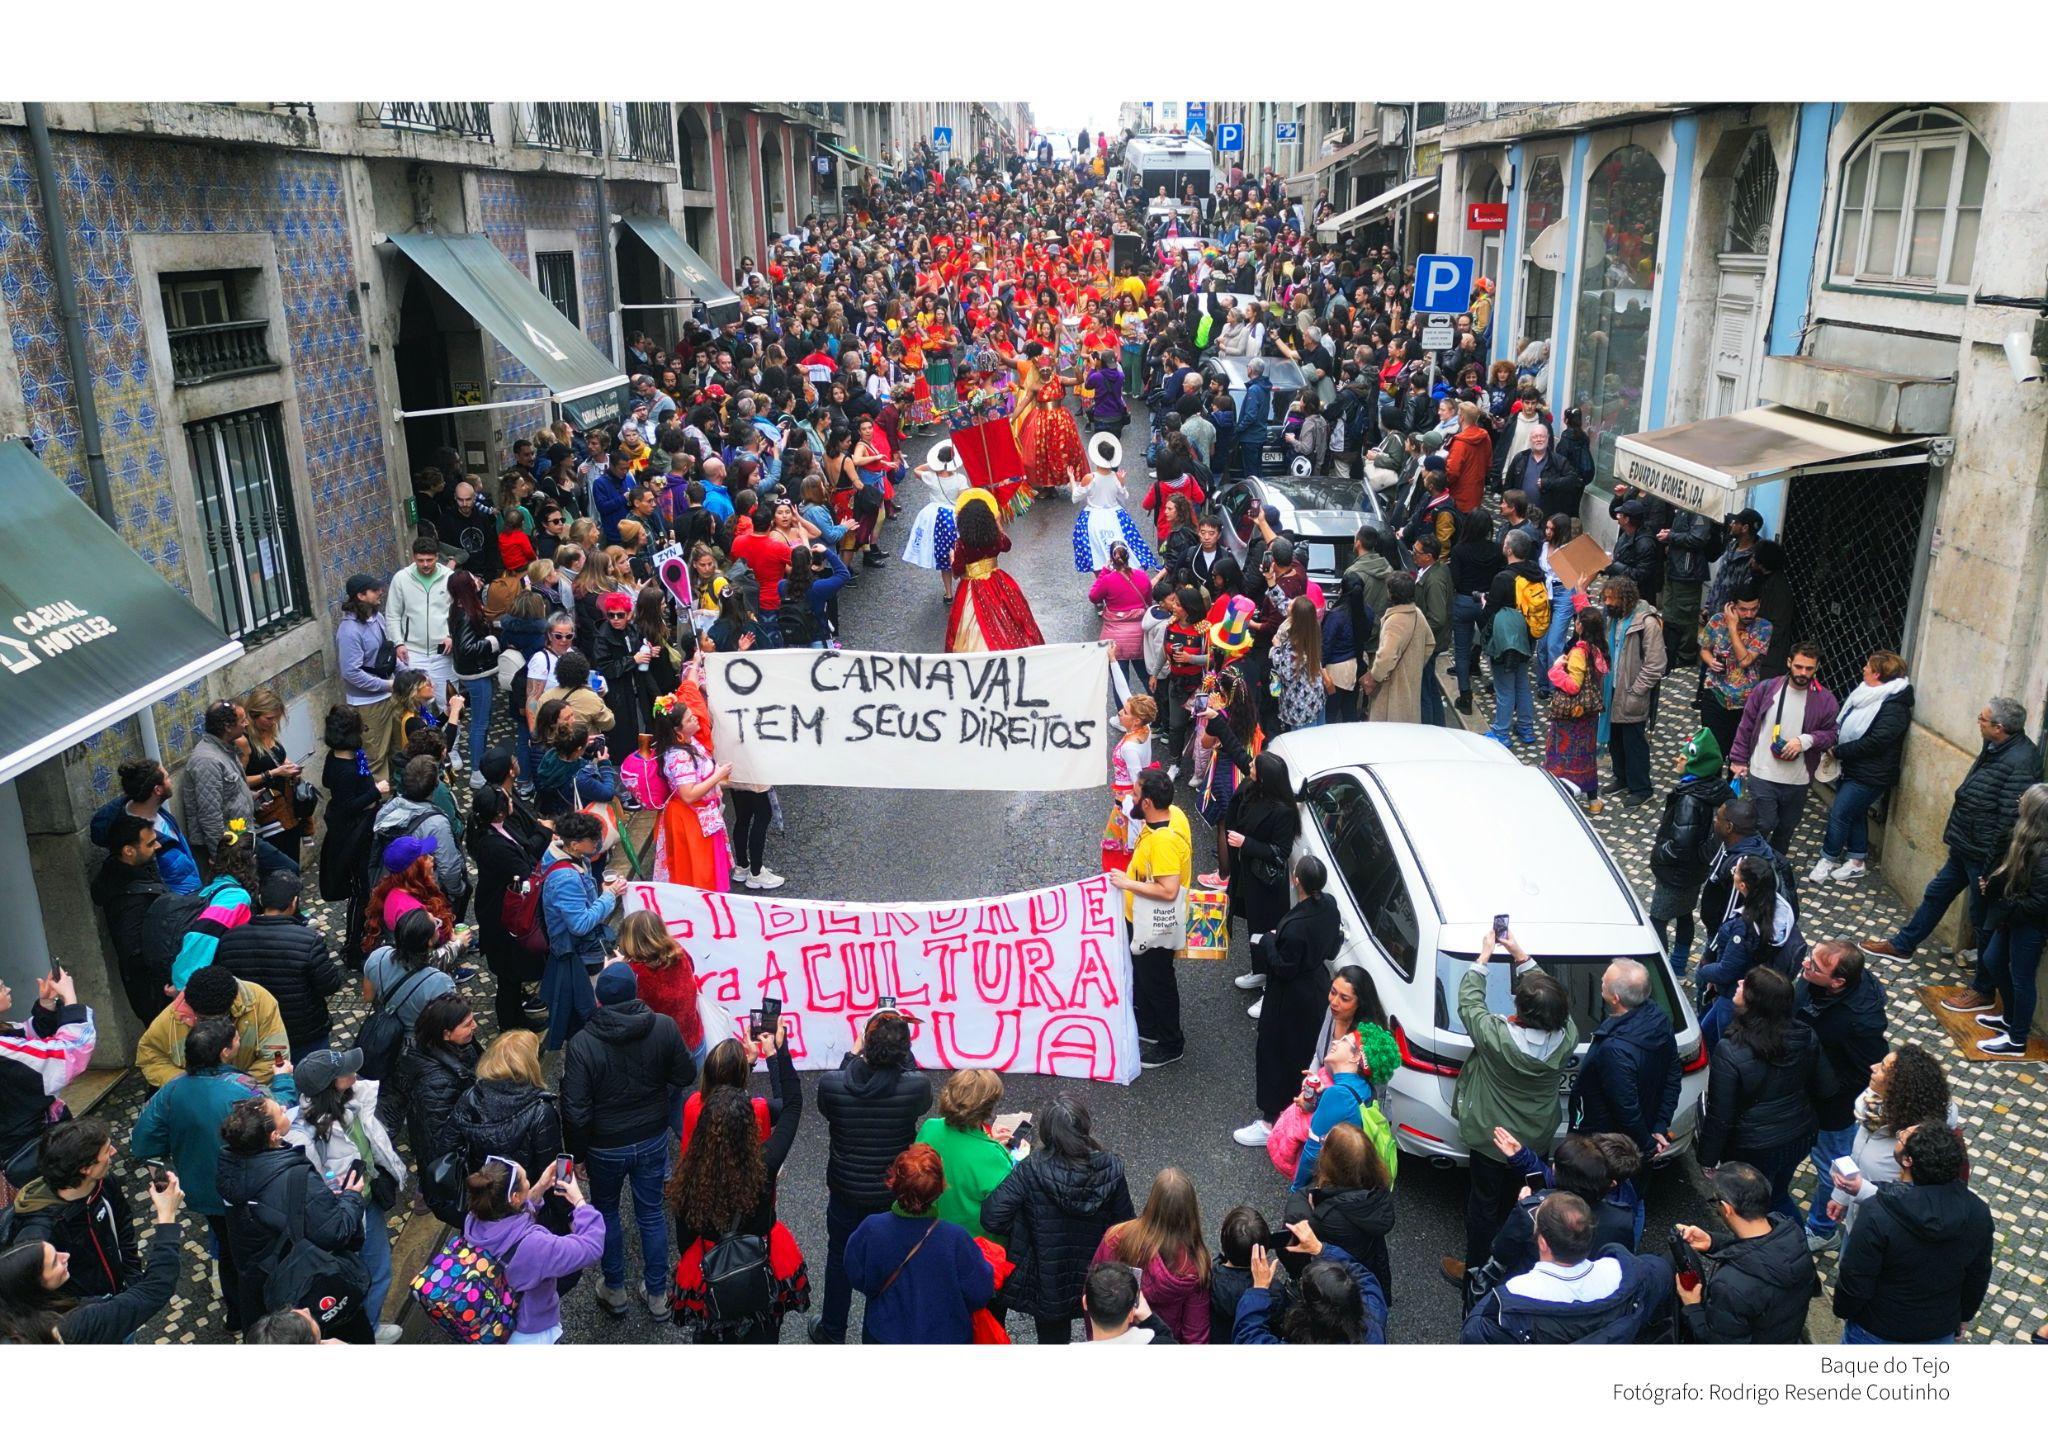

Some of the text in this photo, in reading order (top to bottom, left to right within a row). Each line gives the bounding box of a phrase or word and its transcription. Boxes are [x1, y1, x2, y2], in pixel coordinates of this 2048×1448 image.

[1223, 127, 1238, 149] P
[1425, 261, 1460, 307] P
[657, 547, 677, 563] ZYN
[725, 651, 1051, 709] O CARNAVAL
[726, 704, 825, 746] TEM
[846, 702, 948, 743] SEUS
[1153, 907, 1175, 915] shared
[1153, 920, 1178, 928] network
[757, 951, 788, 1003] A
[801, 934, 1119, 1012] CULTURA
